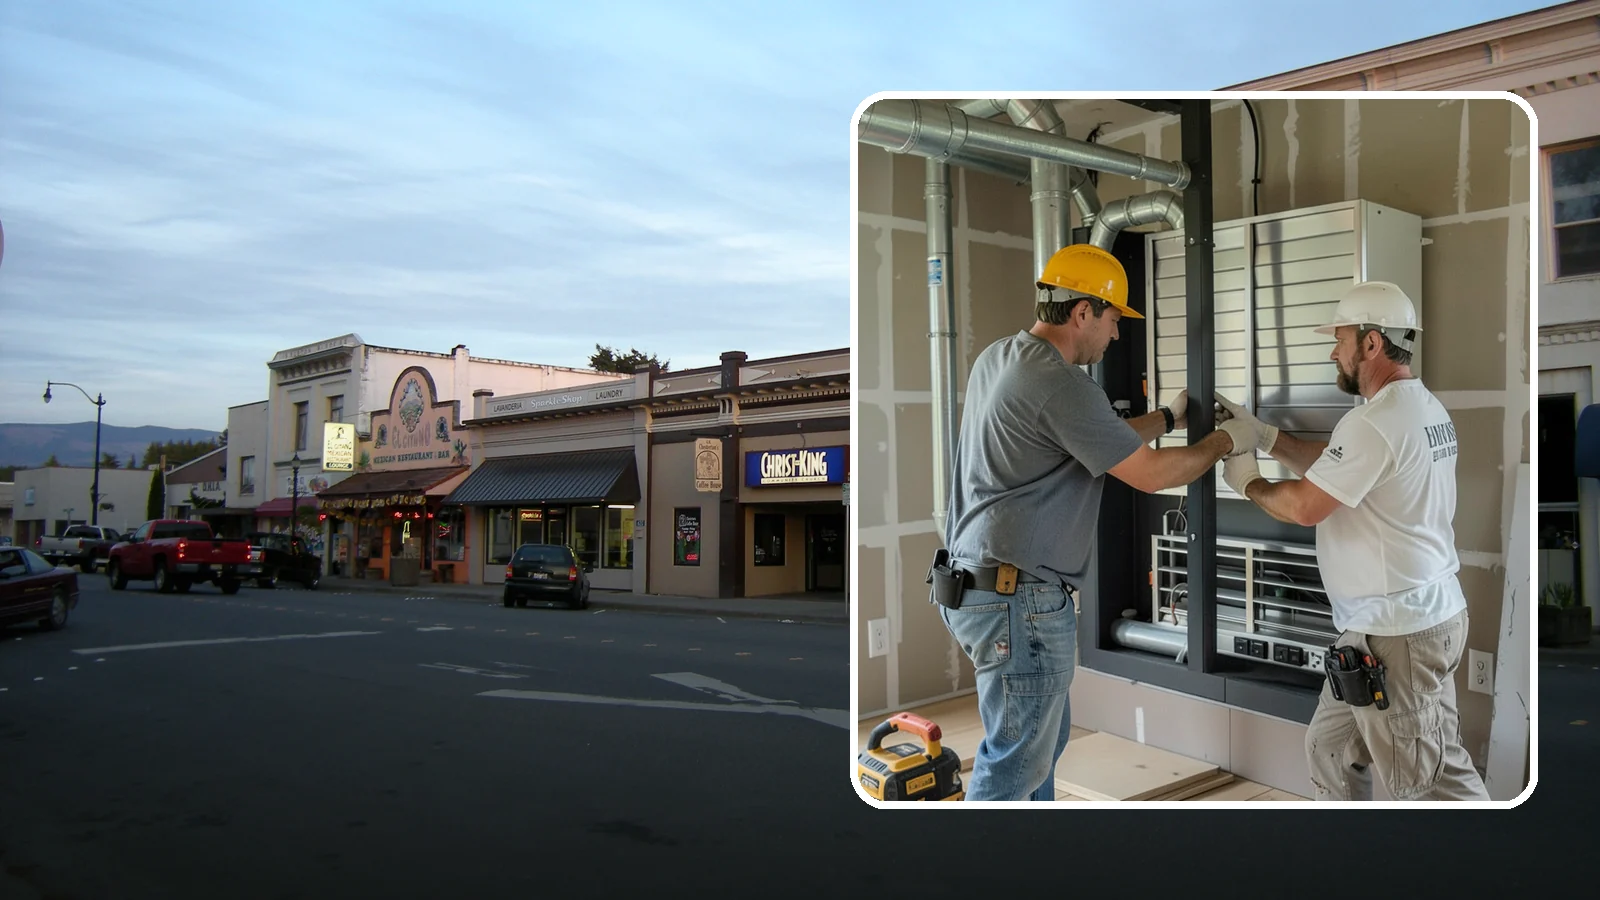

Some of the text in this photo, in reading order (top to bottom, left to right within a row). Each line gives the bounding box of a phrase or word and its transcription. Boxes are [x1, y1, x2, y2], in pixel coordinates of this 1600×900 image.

[531, 394, 583, 408] Sparkle Shop
[596, 389, 623, 400] LAUNDRY
[494, 402, 522, 413] LAVANDERIA
[374, 450, 450, 464] MEXICAN RESTAURANT BAR
[761, 450, 827, 478] CHRIST KING
